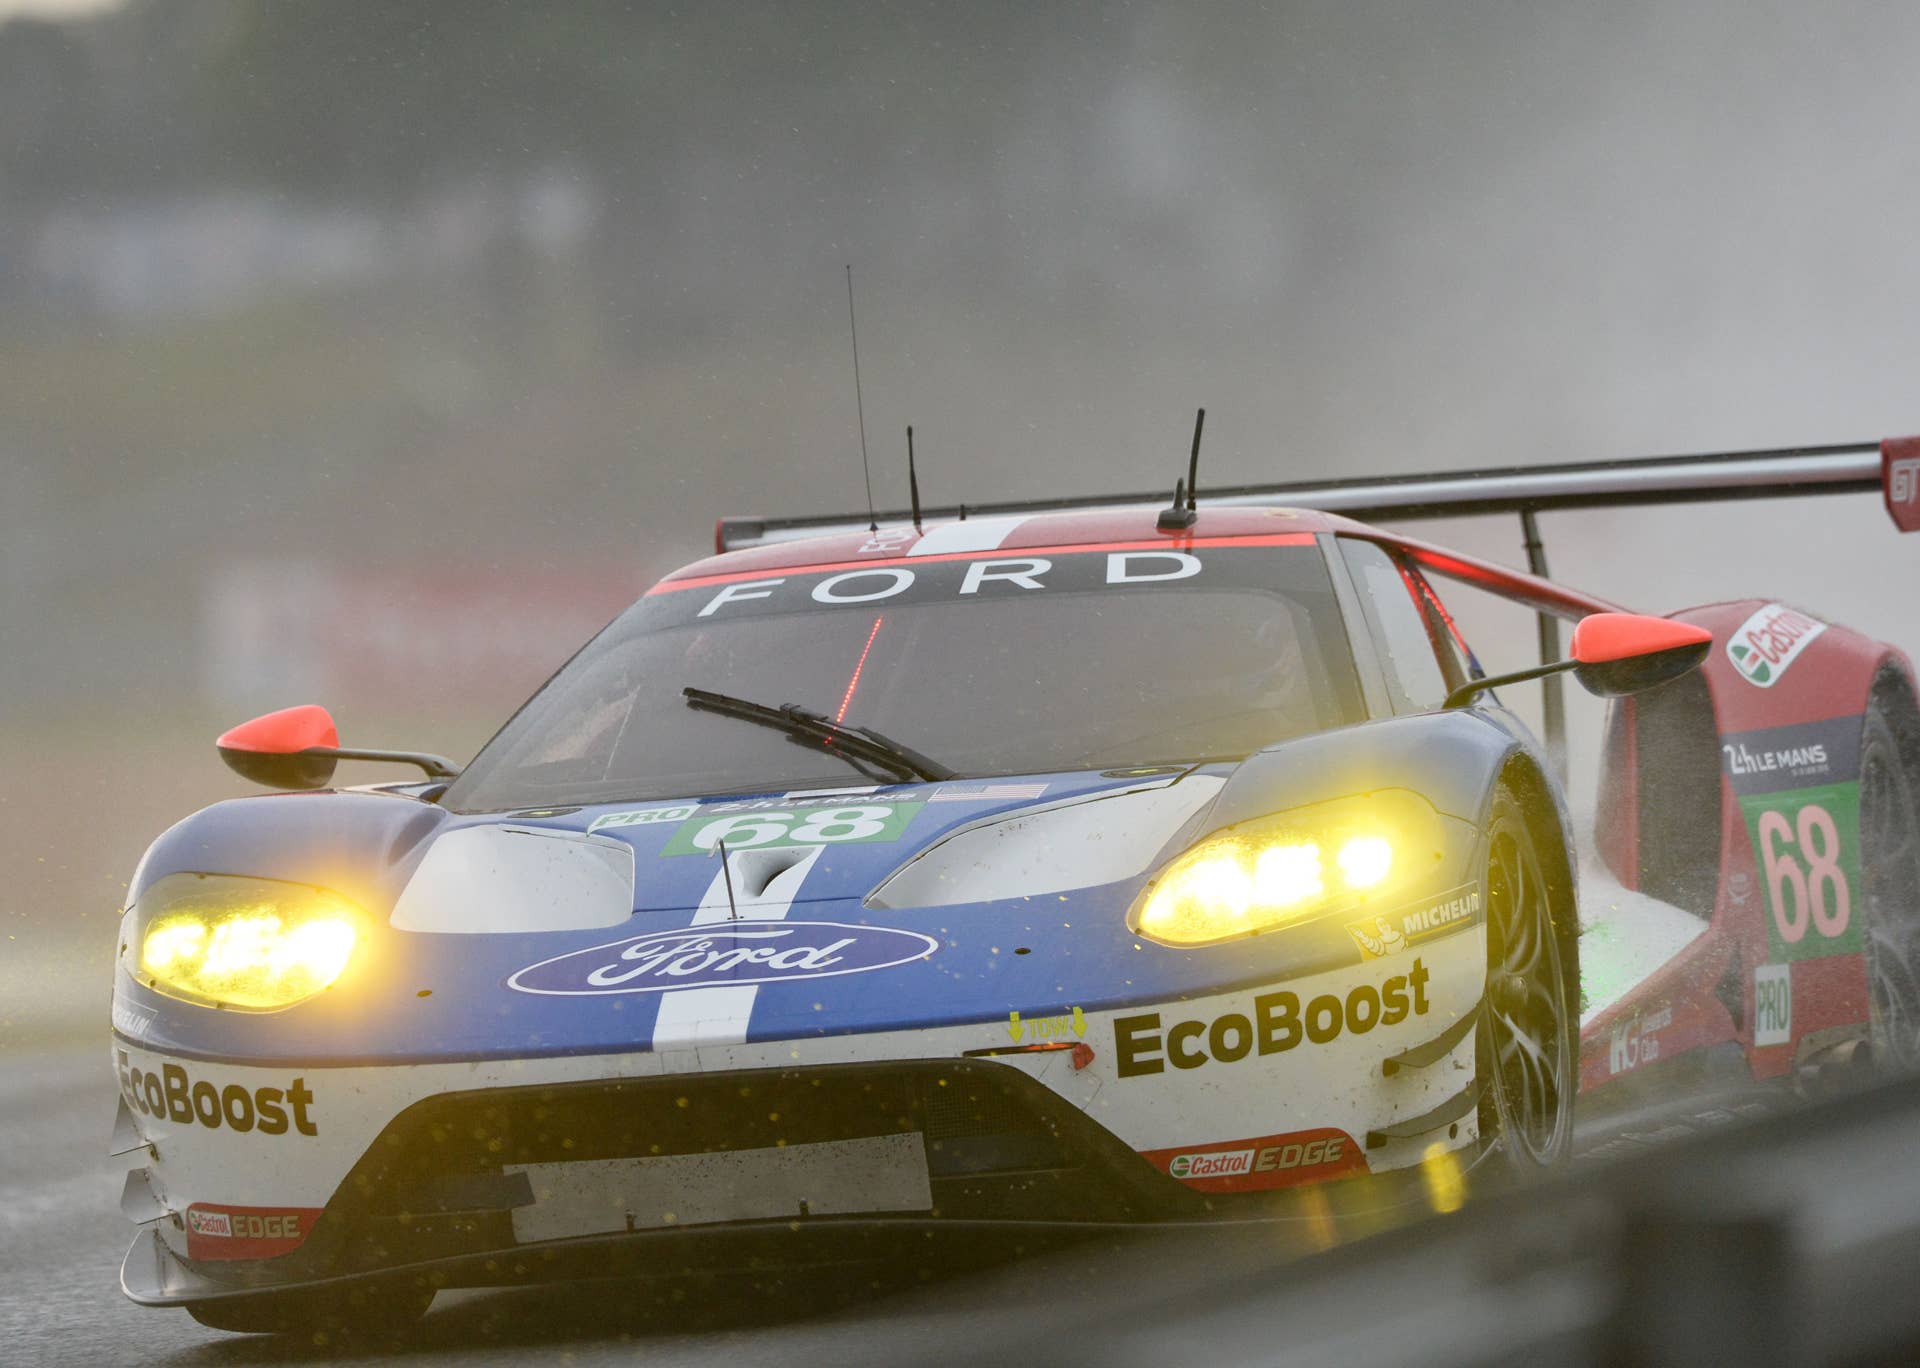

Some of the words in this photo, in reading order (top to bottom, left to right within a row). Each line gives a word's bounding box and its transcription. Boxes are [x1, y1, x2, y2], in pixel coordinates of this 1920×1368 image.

[697, 552, 1202, 617] FORD
[1756, 752, 1777, 771] LE
[1776, 745, 1827, 768] MANS
[595, 808, 690, 827] PRO
[692, 806, 893, 849] 68
[1758, 806, 1850, 942] 68
[1403, 894, 1479, 934] MICHELIN
[587, 930, 856, 986] Ford
[1026, 1015, 1069, 1038] TOW
[1114, 957, 1430, 1079] EcoBoost
[1756, 977, 1790, 1033] PRO
[117, 1048, 318, 1136] EcoBoost
[1190, 1151, 1250, 1175] Castrol
[1254, 1136, 1347, 1172] EDGE
[199, 1213, 230, 1234] Castrol
[231, 1215, 301, 1239] EDGE
